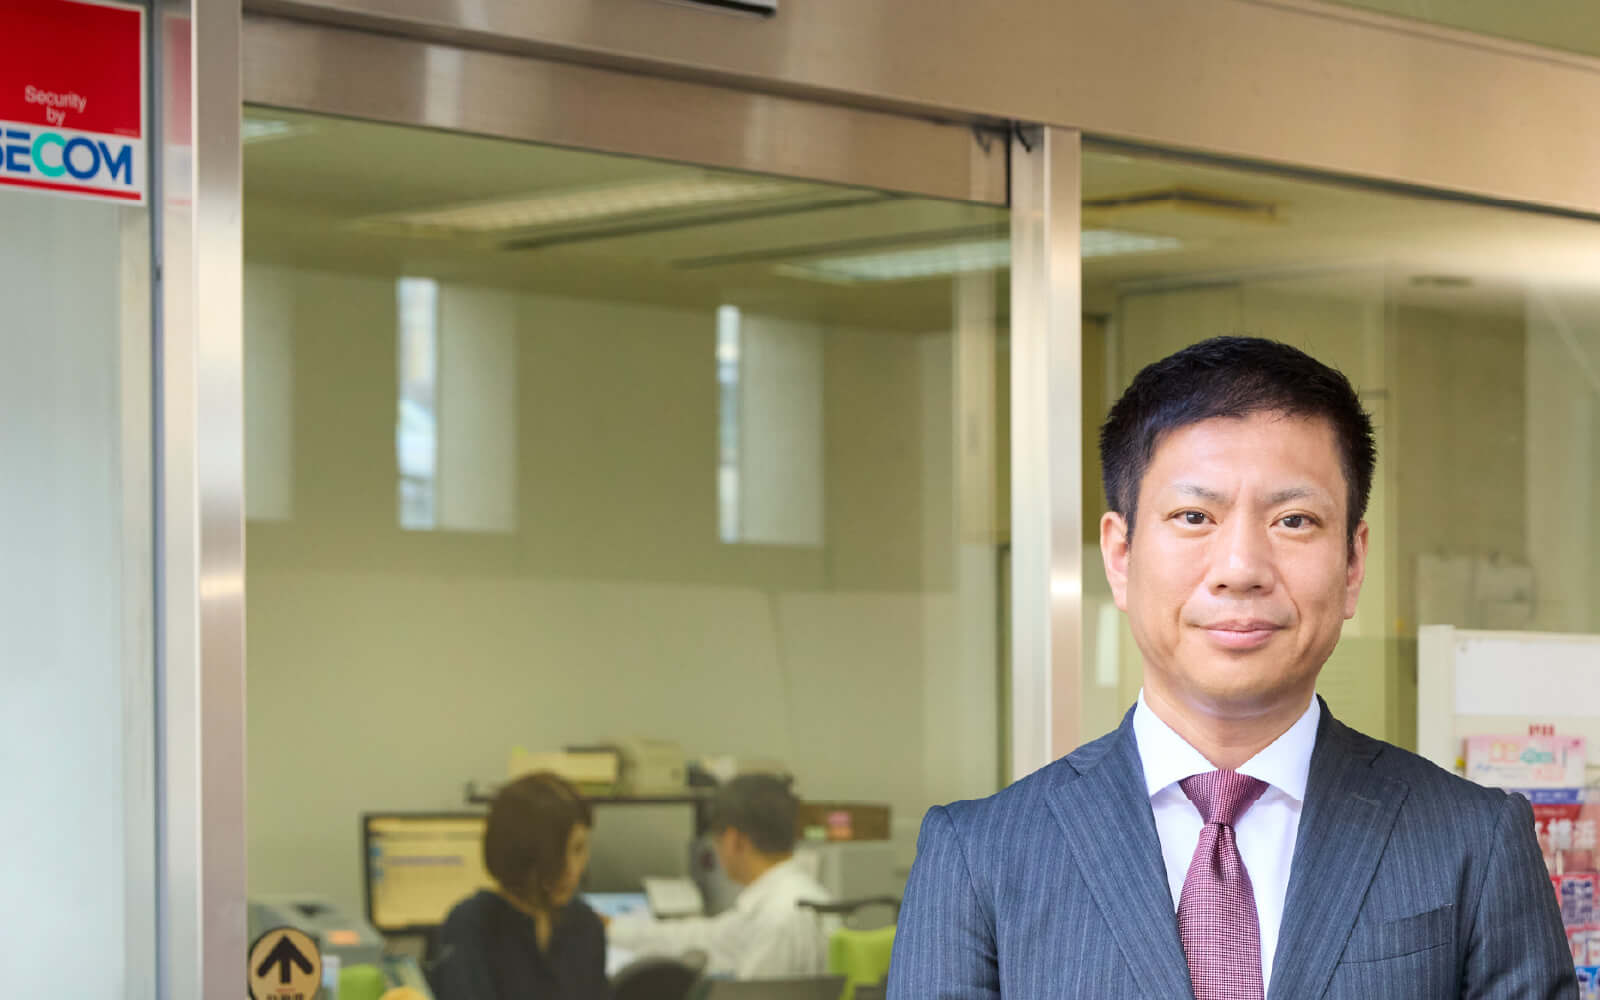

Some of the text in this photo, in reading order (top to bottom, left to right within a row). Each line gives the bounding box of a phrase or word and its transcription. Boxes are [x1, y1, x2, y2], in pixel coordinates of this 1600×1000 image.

[25, 84, 87, 113] Security
[46, 105, 66, 127] by
[0, 129, 132, 185] ECOM
